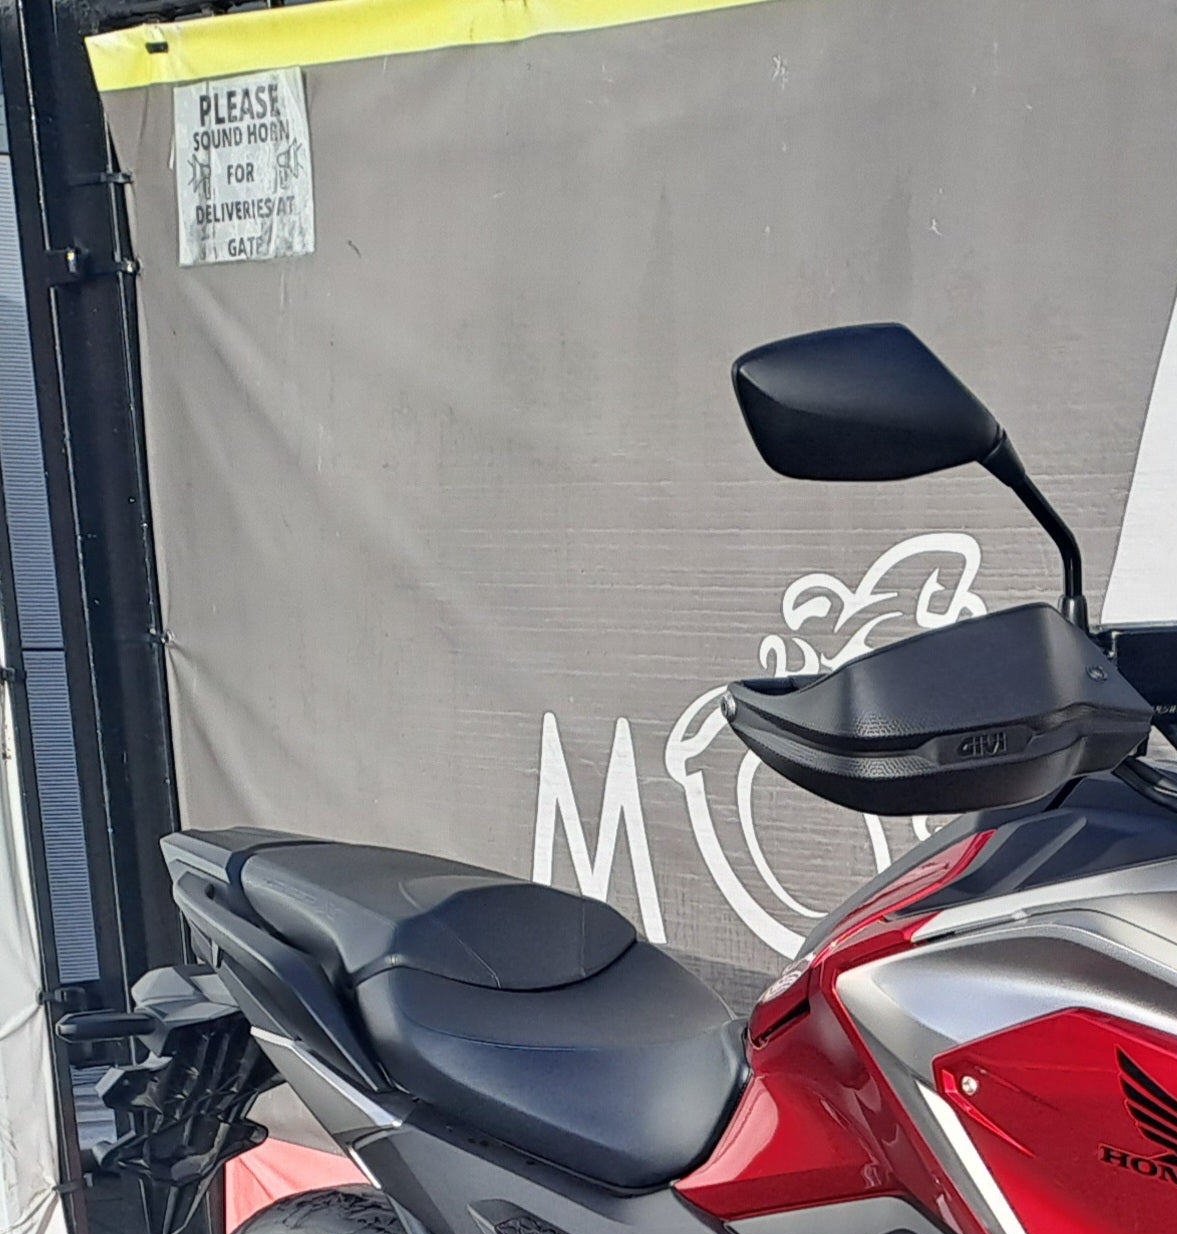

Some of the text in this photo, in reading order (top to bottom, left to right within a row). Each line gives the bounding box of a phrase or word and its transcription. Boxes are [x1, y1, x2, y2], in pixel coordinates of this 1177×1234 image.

[199, 83, 281, 127] PLEASE
[193, 118, 291, 152] SOUND HORN
[226, 162, 255, 185] FOR
[195, 195, 296, 225] DELIVERIES AT
